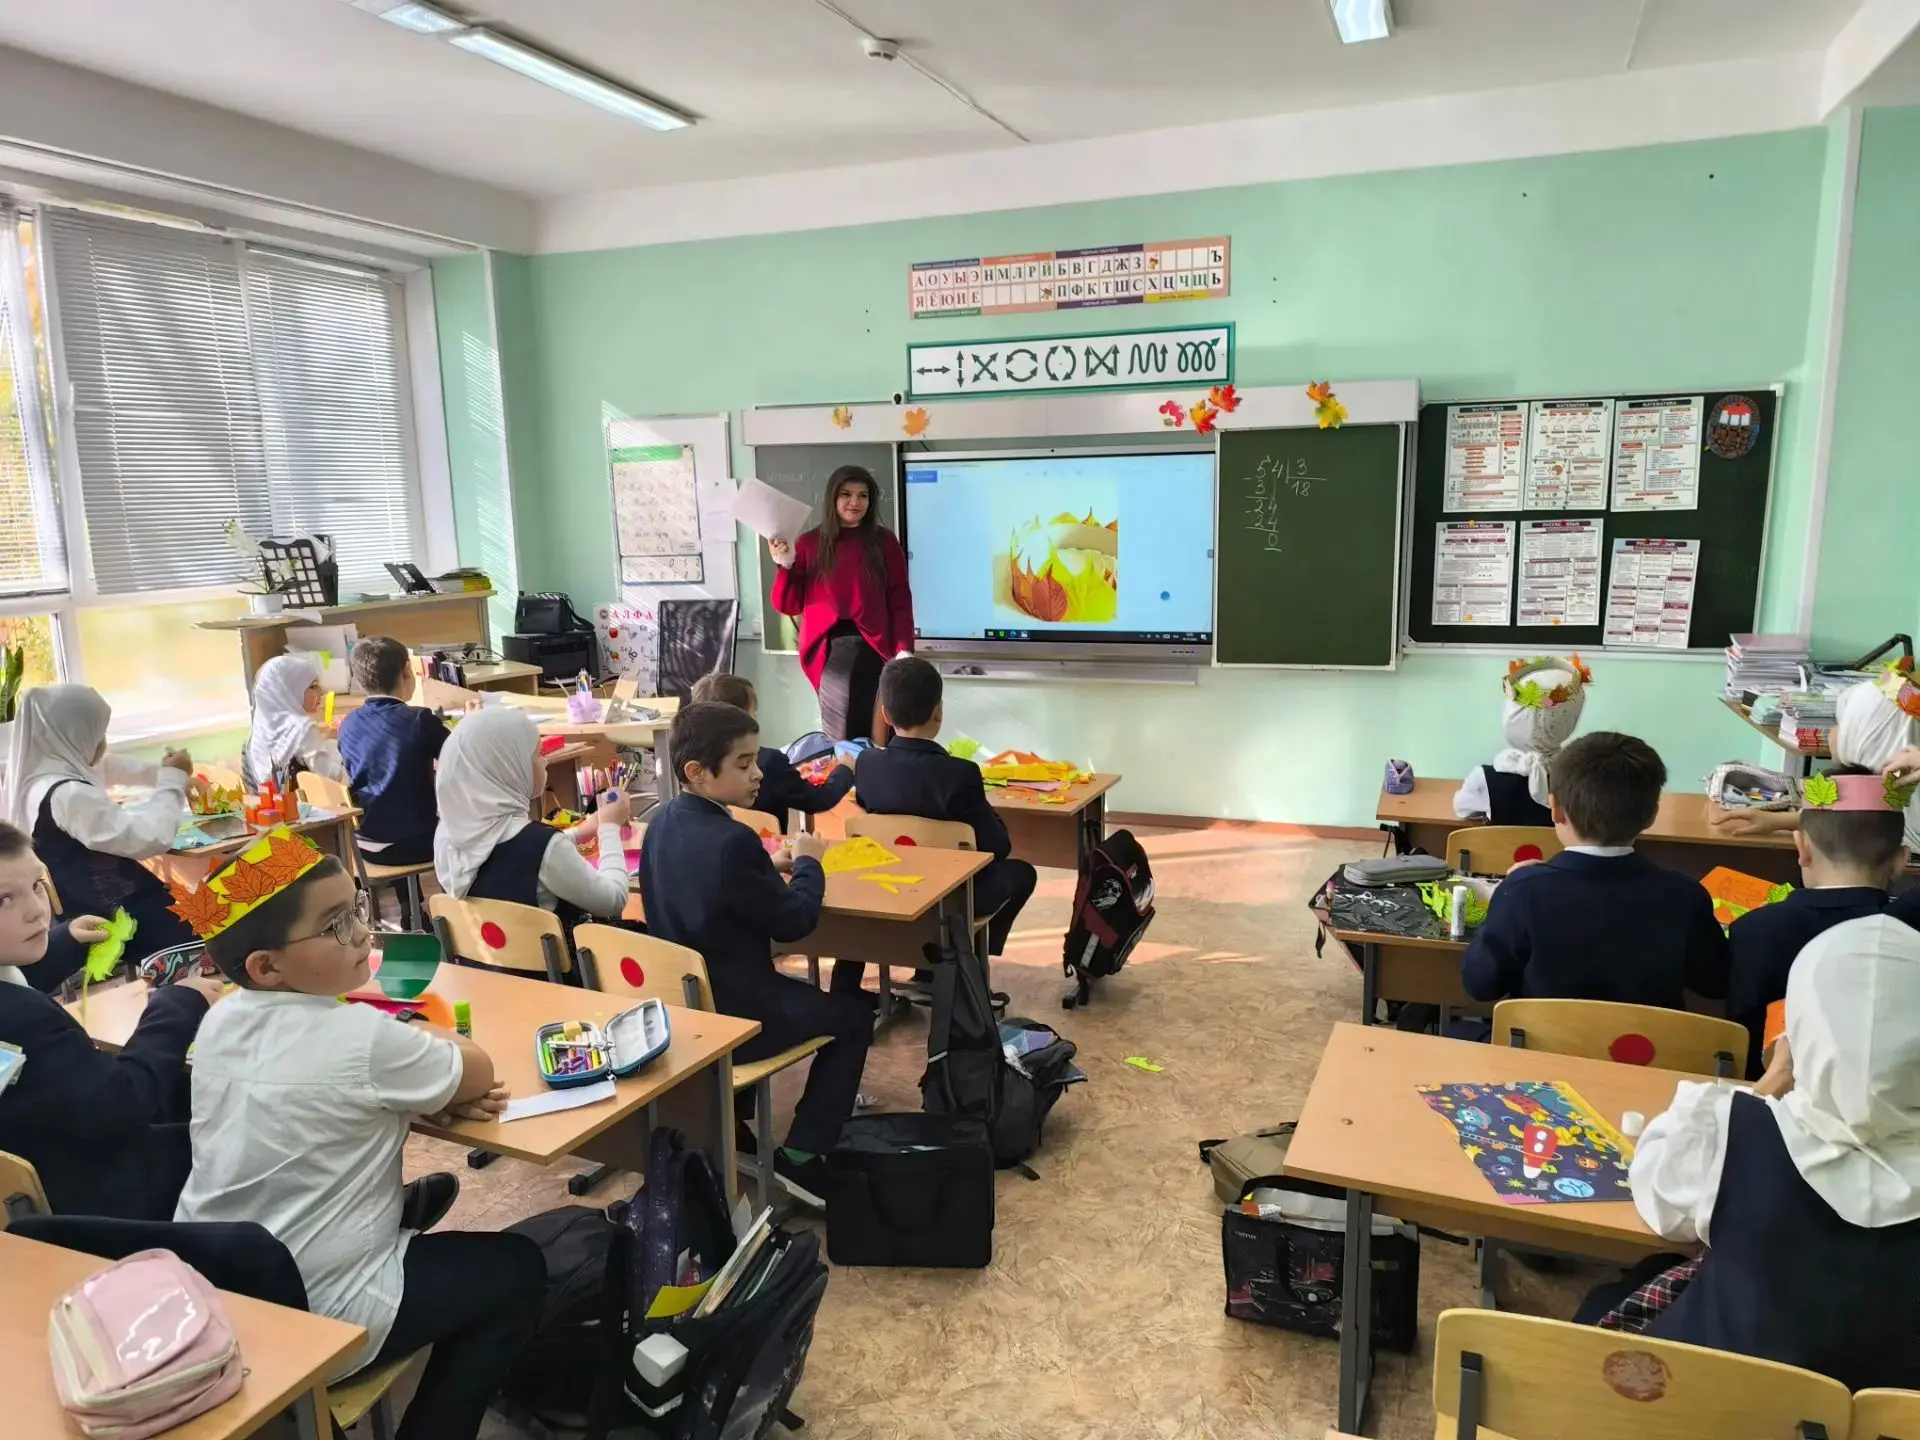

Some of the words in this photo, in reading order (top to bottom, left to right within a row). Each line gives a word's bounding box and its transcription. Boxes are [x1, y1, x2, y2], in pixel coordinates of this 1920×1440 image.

[915, 275, 924, 287] А
[928, 273, 938, 285] О
[942, 271, 950, 285] У
[955, 272, 967, 284] Ы
[970, 270, 980, 282] Э
[984, 268, 994, 281] Н
[997, 267, 1009, 281] М
[1012, 266, 1022, 279] Л
[1028, 265, 1036, 278] Р
[1042, 261, 1052, 276] Й
[1057, 262, 1067, 276] Б
[1072, 260, 1082, 275] В
[1087, 260, 1096, 273] Г
[1101, 259, 1112, 273] Д
[1115, 257, 1129, 271] Ж
[1133, 255, 1142, 269] З
[1211, 249, 1222, 263] Ъ
[916, 295, 924, 308] Я
[930, 291, 938, 307] Ё
[940, 293, 954, 306] Ю
[954, 292, 966, 304] И
[971, 291, 980, 303] Е
[1057, 284, 1067, 297] П
[1071, 282, 1083, 297] Ф
[1087, 282, 1097, 295] К
[1102, 281, 1111, 294] Т
[1115, 279, 1129, 294] Ш
[1132, 278, 1143, 292] С
[1148, 276, 1158, 291] Х
[1163, 276, 1175, 292] Ц
[1179, 274, 1189, 286] Ч
[1192, 273, 1208, 289] Щ
[1211, 272, 1221, 285] Ь
